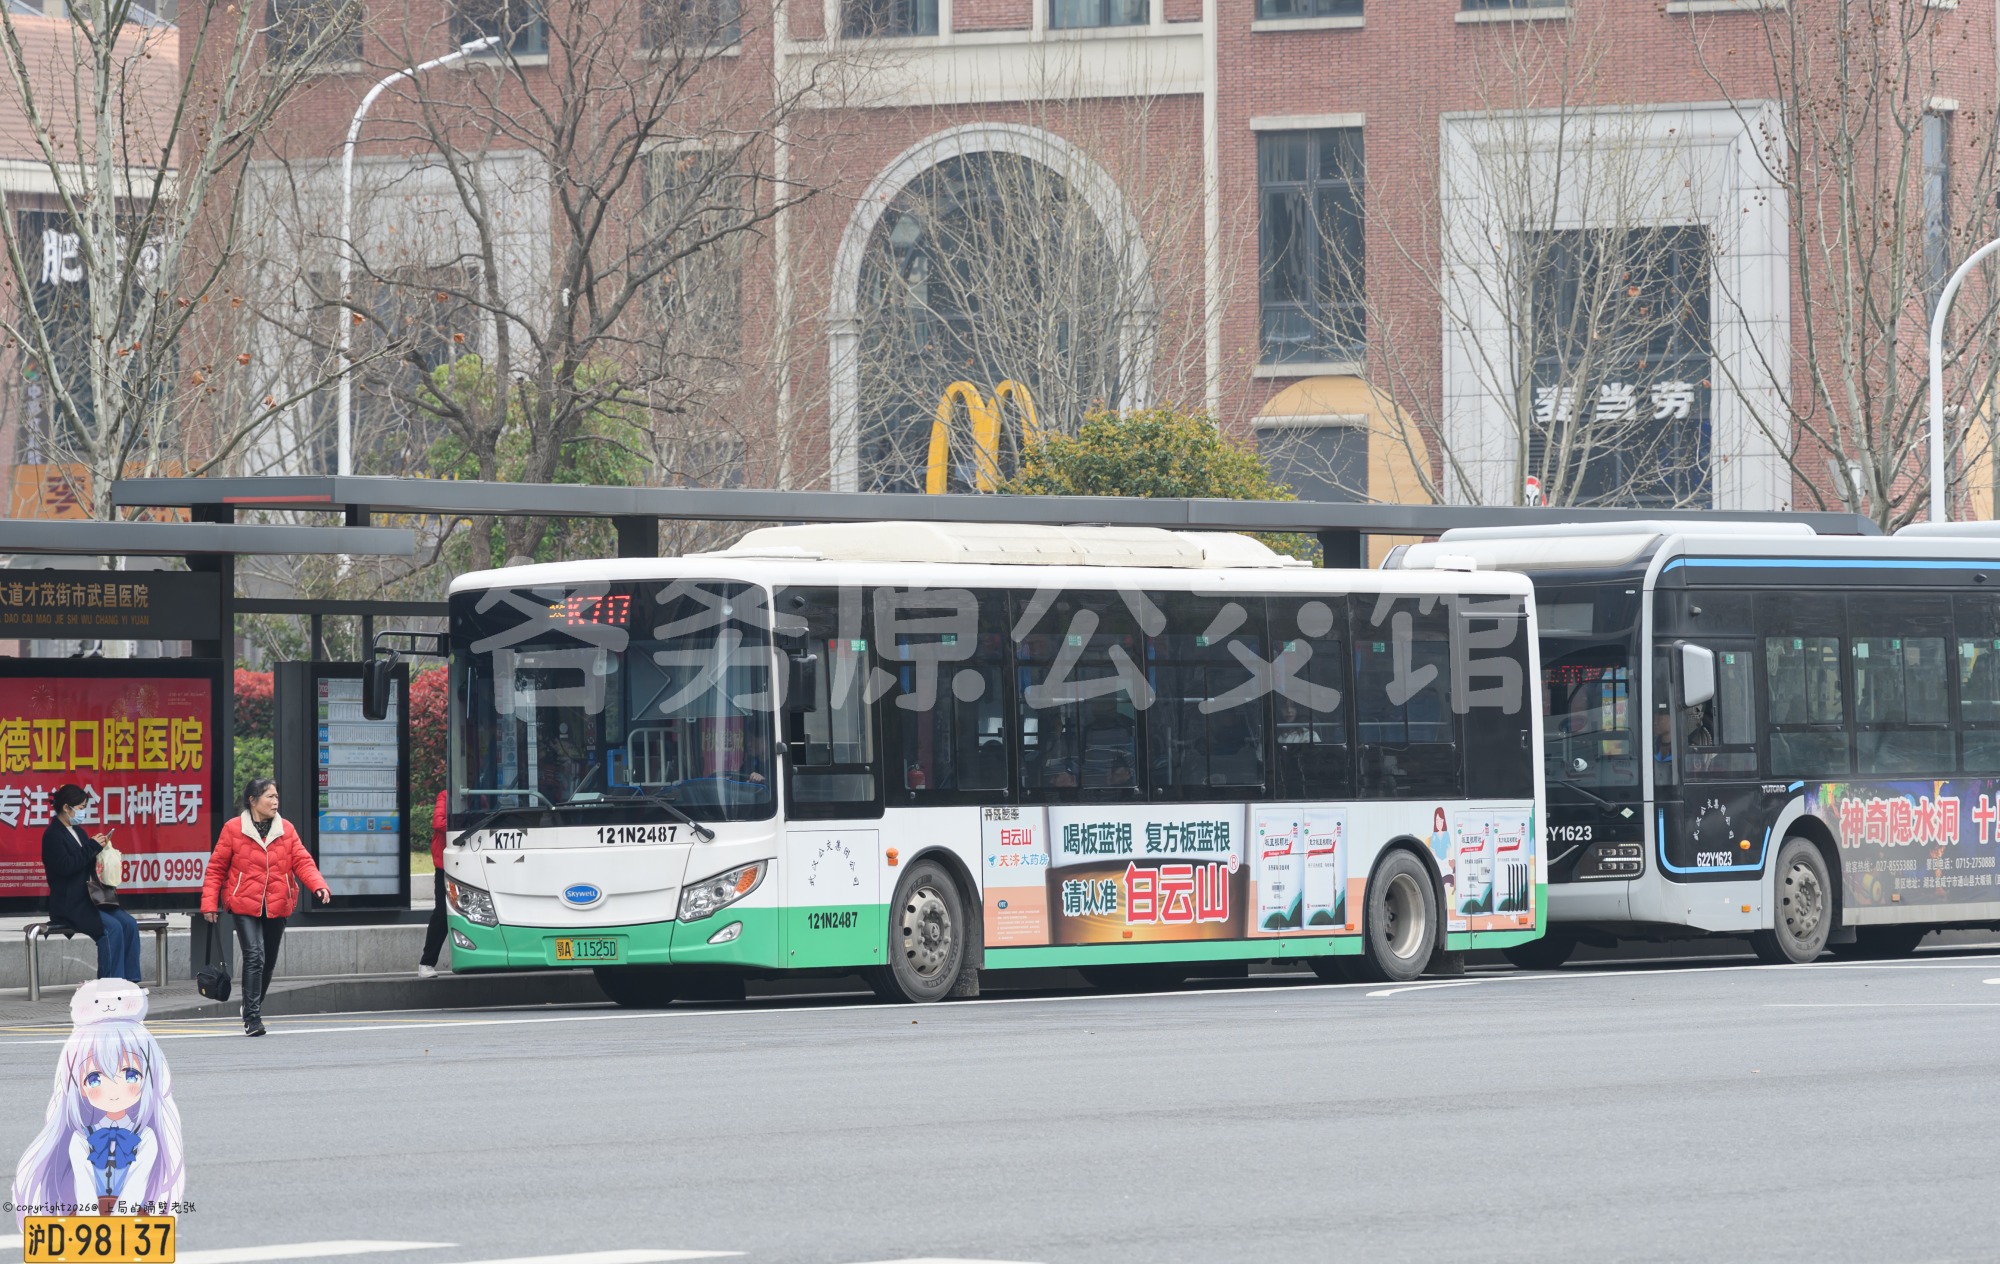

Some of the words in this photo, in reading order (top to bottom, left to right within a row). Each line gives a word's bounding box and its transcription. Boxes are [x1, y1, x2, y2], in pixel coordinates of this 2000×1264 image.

[1535, 381, 1695, 423] 麦当劳
[4, 613, 19, 624] DAO
[22, 613, 33, 624] CAI
[36, 614, 51, 624] MAO
[55, 614, 64, 625] JIE
[67, 614, 78, 625] SHI
[81, 614, 92, 625] WU
[96, 615, 119, 625] CHANG
[121, 615, 128, 625] YI
[131, 615, 149, 625] YUAN
[567, 595, 631, 625] K717
[1840, 797, 1960, 847] 神奇隐水洞
[494, 832, 523, 849] K717
[597, 825, 678, 844] 121N2487
[1000, 829, 1032, 846] 白云山
[1063, 823, 1133, 855] 喝板蓝根
[1145, 821, 1231, 853] 复方板蓝根
[999, 853, 1049, 867] 天济大药房
[1696, 851, 1733, 868] 622Y1623
[121, 859, 161, 883] 8700
[164, 858, 204, 881] 9999
[1062, 879, 1118, 915] 请认准
[1124, 862, 1230, 923] 白云山
[807, 912, 858, 930] 121N2487
